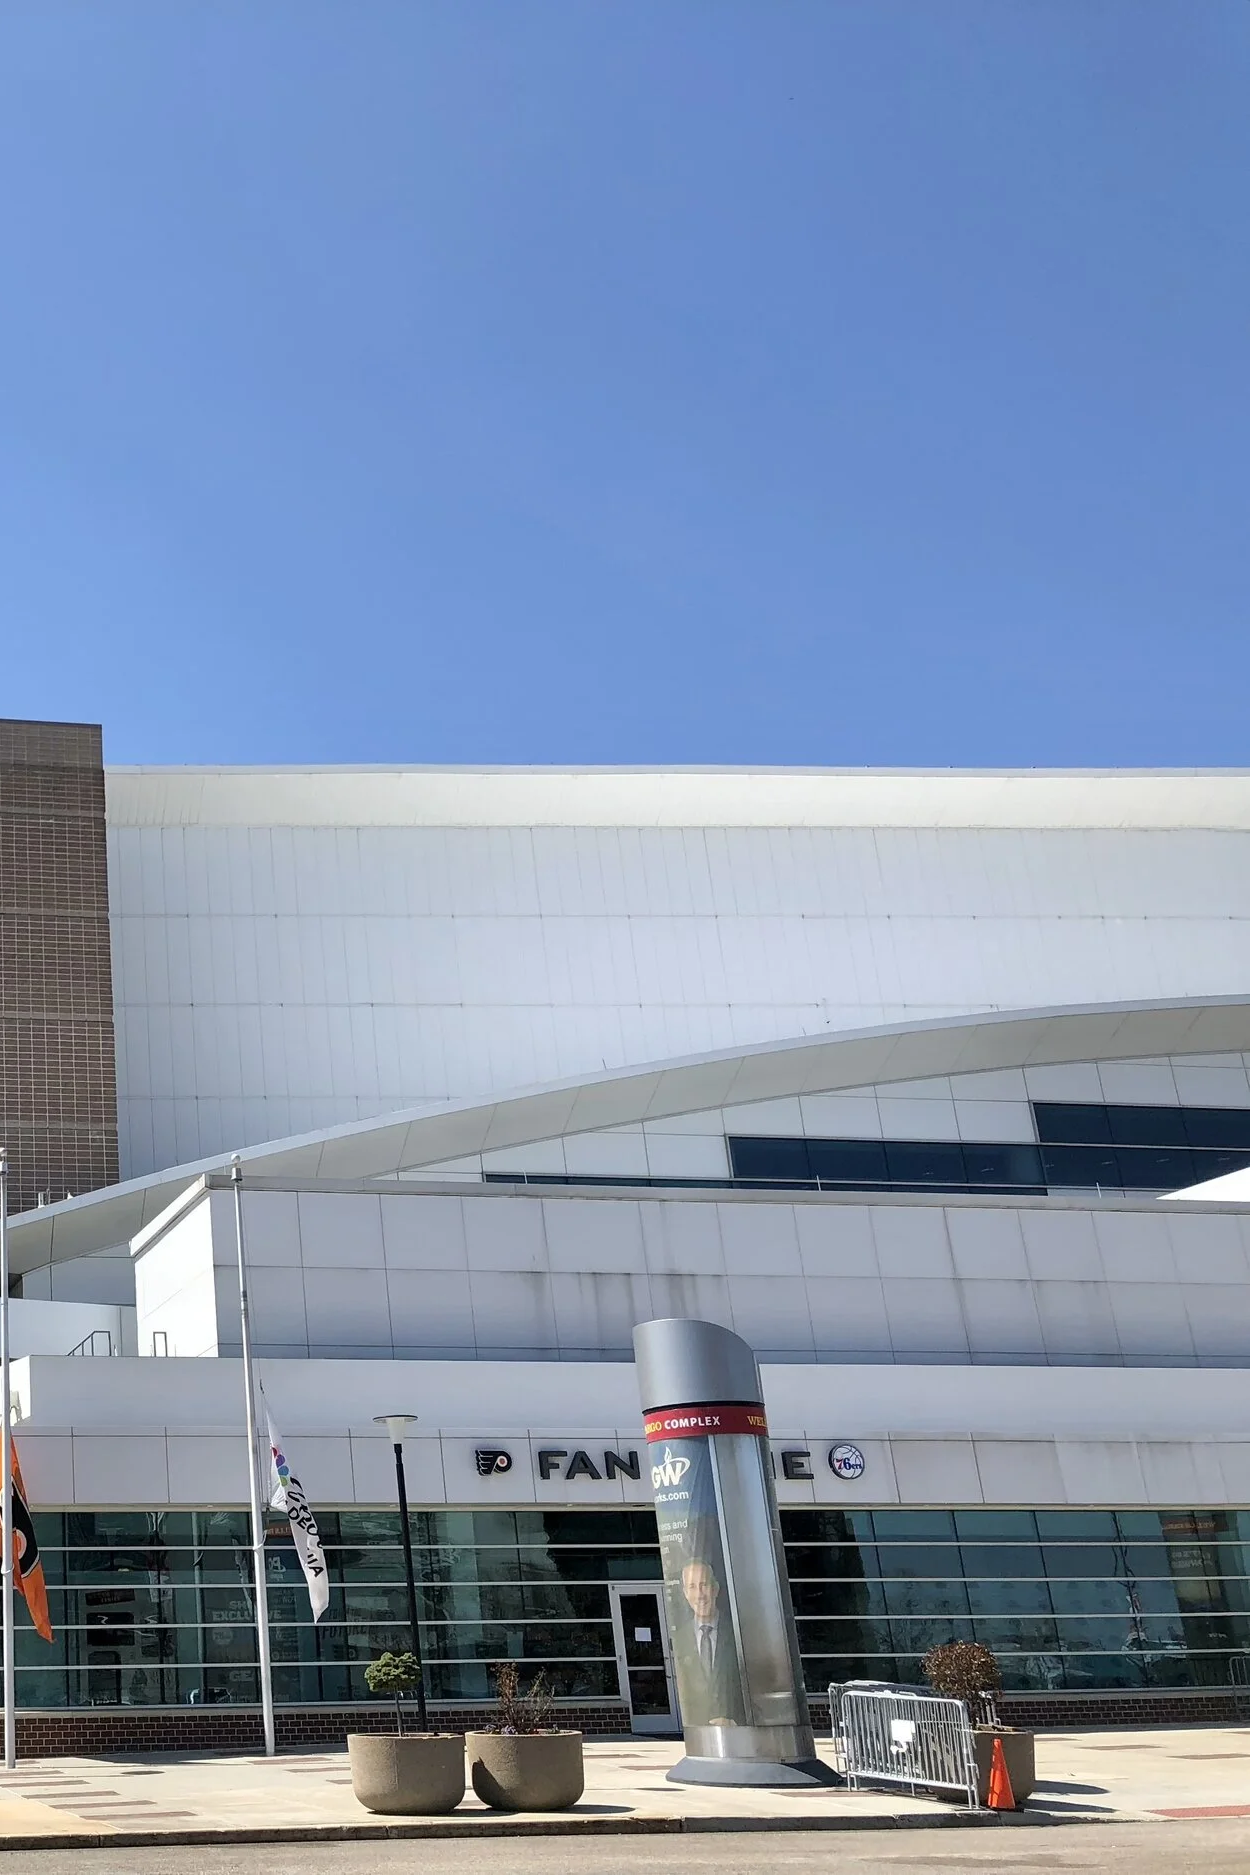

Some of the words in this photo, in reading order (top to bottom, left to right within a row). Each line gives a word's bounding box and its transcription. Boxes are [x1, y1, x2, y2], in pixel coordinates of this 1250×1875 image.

[664, 1416, 721, 1430] COMPLEX
[538, 1450, 641, 1480] FAN
[212, 1610, 282, 1621] EXCLUVE
